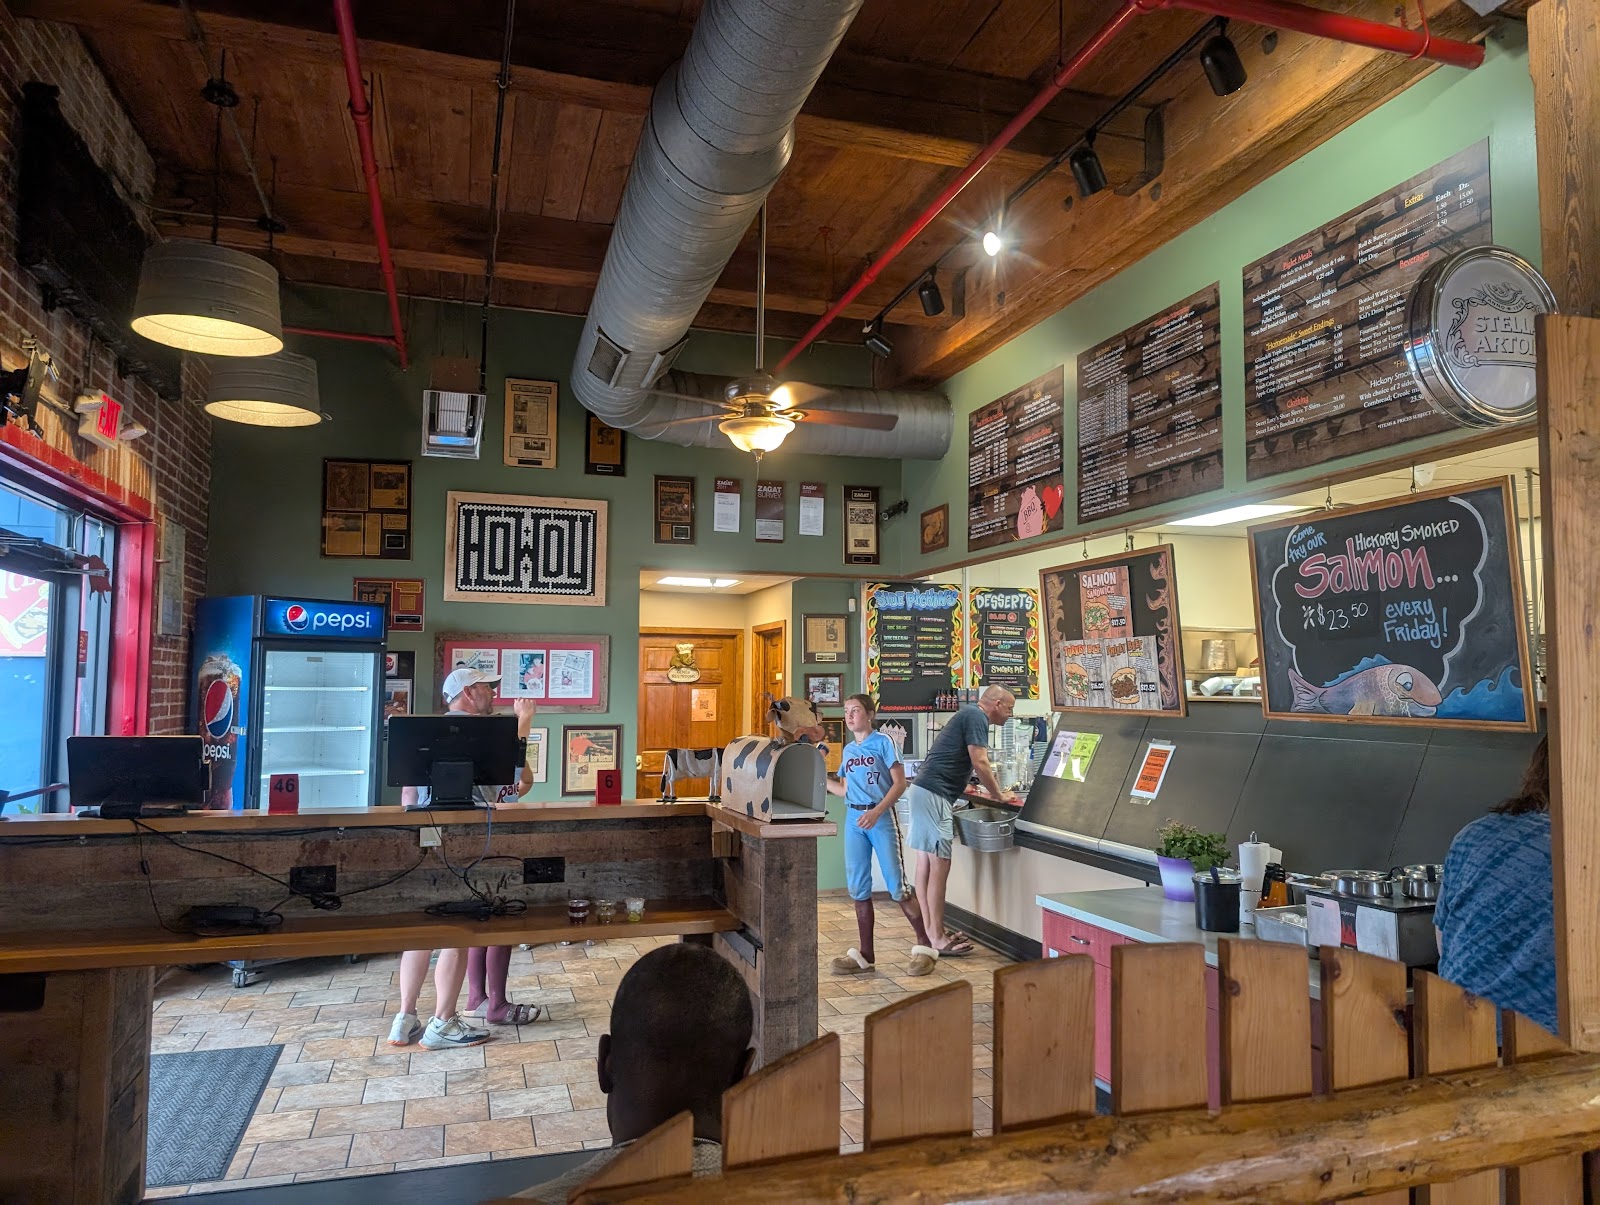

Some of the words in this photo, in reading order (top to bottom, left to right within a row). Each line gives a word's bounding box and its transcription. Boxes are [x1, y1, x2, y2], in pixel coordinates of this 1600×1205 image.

[1404, 189, 1424, 208] Extras
[1435, 191, 1450, 202] Each
[1459, 181, 1470, 191] Dz.
[1358, 240, 1367, 249] Roll
[1373, 232, 1387, 242] Butter
[1436, 202, 1447, 211] 1.50
[1459, 189, 1473, 200] 15.00
[1358, 241, 1383, 257] Homemade
[1384, 228, 1408, 244] Cornbread
[1437, 210, 1447, 219] 1.75
[1459, 197, 1473, 208] 17.50
[1358, 257, 1367, 265] Hot
[1368, 252, 1378, 260] Dog
[1436, 218, 1447, 227] 4.50
[1282, 257, 1296, 271] Piglet
[1296, 249, 1312, 264] Meals
[1399, 250, 1430, 271] Beverages
[1325, 268, 1334, 276] each
[1306, 293, 1321, 305] Smoked
[1359, 294, 1374, 305] Bottled
[1375, 289, 1388, 298] Water
[1372, 295, 1388, 307] Bottled
[1389, 291, 1400, 300] Soda
[1275, 303, 1283, 311] Pork
[1359, 311, 1370, 320] Kid's
[1371, 306, 1384, 315] Drink
[1385, 309, 1396, 319] Juice
[1396, 305, 1405, 313] Box
[1272, 310, 1286, 320] Chicken
[1298, 325, 1312, 337] Sweet
[1313, 318, 1334, 332] Endings
[1359, 325, 1378, 336] Fountain
[1379, 320, 1390, 328] Soda
[1475, 316, 1536, 336] STELL
[1288, 350, 1297, 358] Chip
[1309, 339, 1326, 349] Pudding
[1334, 331, 1342, 339] 6.00
[1359, 335, 1372, 343] Sweet
[1360, 343, 1372, 351] Sweet
[1360, 351, 1373, 359] Sweet
[1334, 360, 1343, 369] 6.00
[1370, 375, 1394, 388] Hickory
[1359, 392, 1371, 401] With
[1372, 387, 1389, 397] choice
[1393, 389, 1410, 399] Creole
[1287, 396, 1309, 409] Clothing
[97, 394, 122, 441] EXIT
[1266, 415, 1279, 424] Lucy's
[1267, 424, 1279, 432] Lucy's
[1280, 418, 1295, 428] Baseball
[757, 485, 782, 493] ZAGAT
[1023, 501, 1035, 521] BBQ
[1306, 532, 1328, 551] OUR
[1082, 571, 1117, 589] SALMON
[362, 593, 388, 603] BEST
[1086, 586, 1115, 599] SANDWICH
[874, 590, 906, 611] SIDE
[975, 593, 1033, 610] DESSERTS
[313, 611, 371, 631] pepsi
[1063, 644, 1086, 658] TURKEY
[1127, 639, 1143, 651] BEEF
[203, 743, 231, 761] pepsi
[845, 755, 875, 773] Rake
[273, 778, 295, 793] 46
[605, 774, 613, 789] 6
[866, 771, 881, 785] 27
